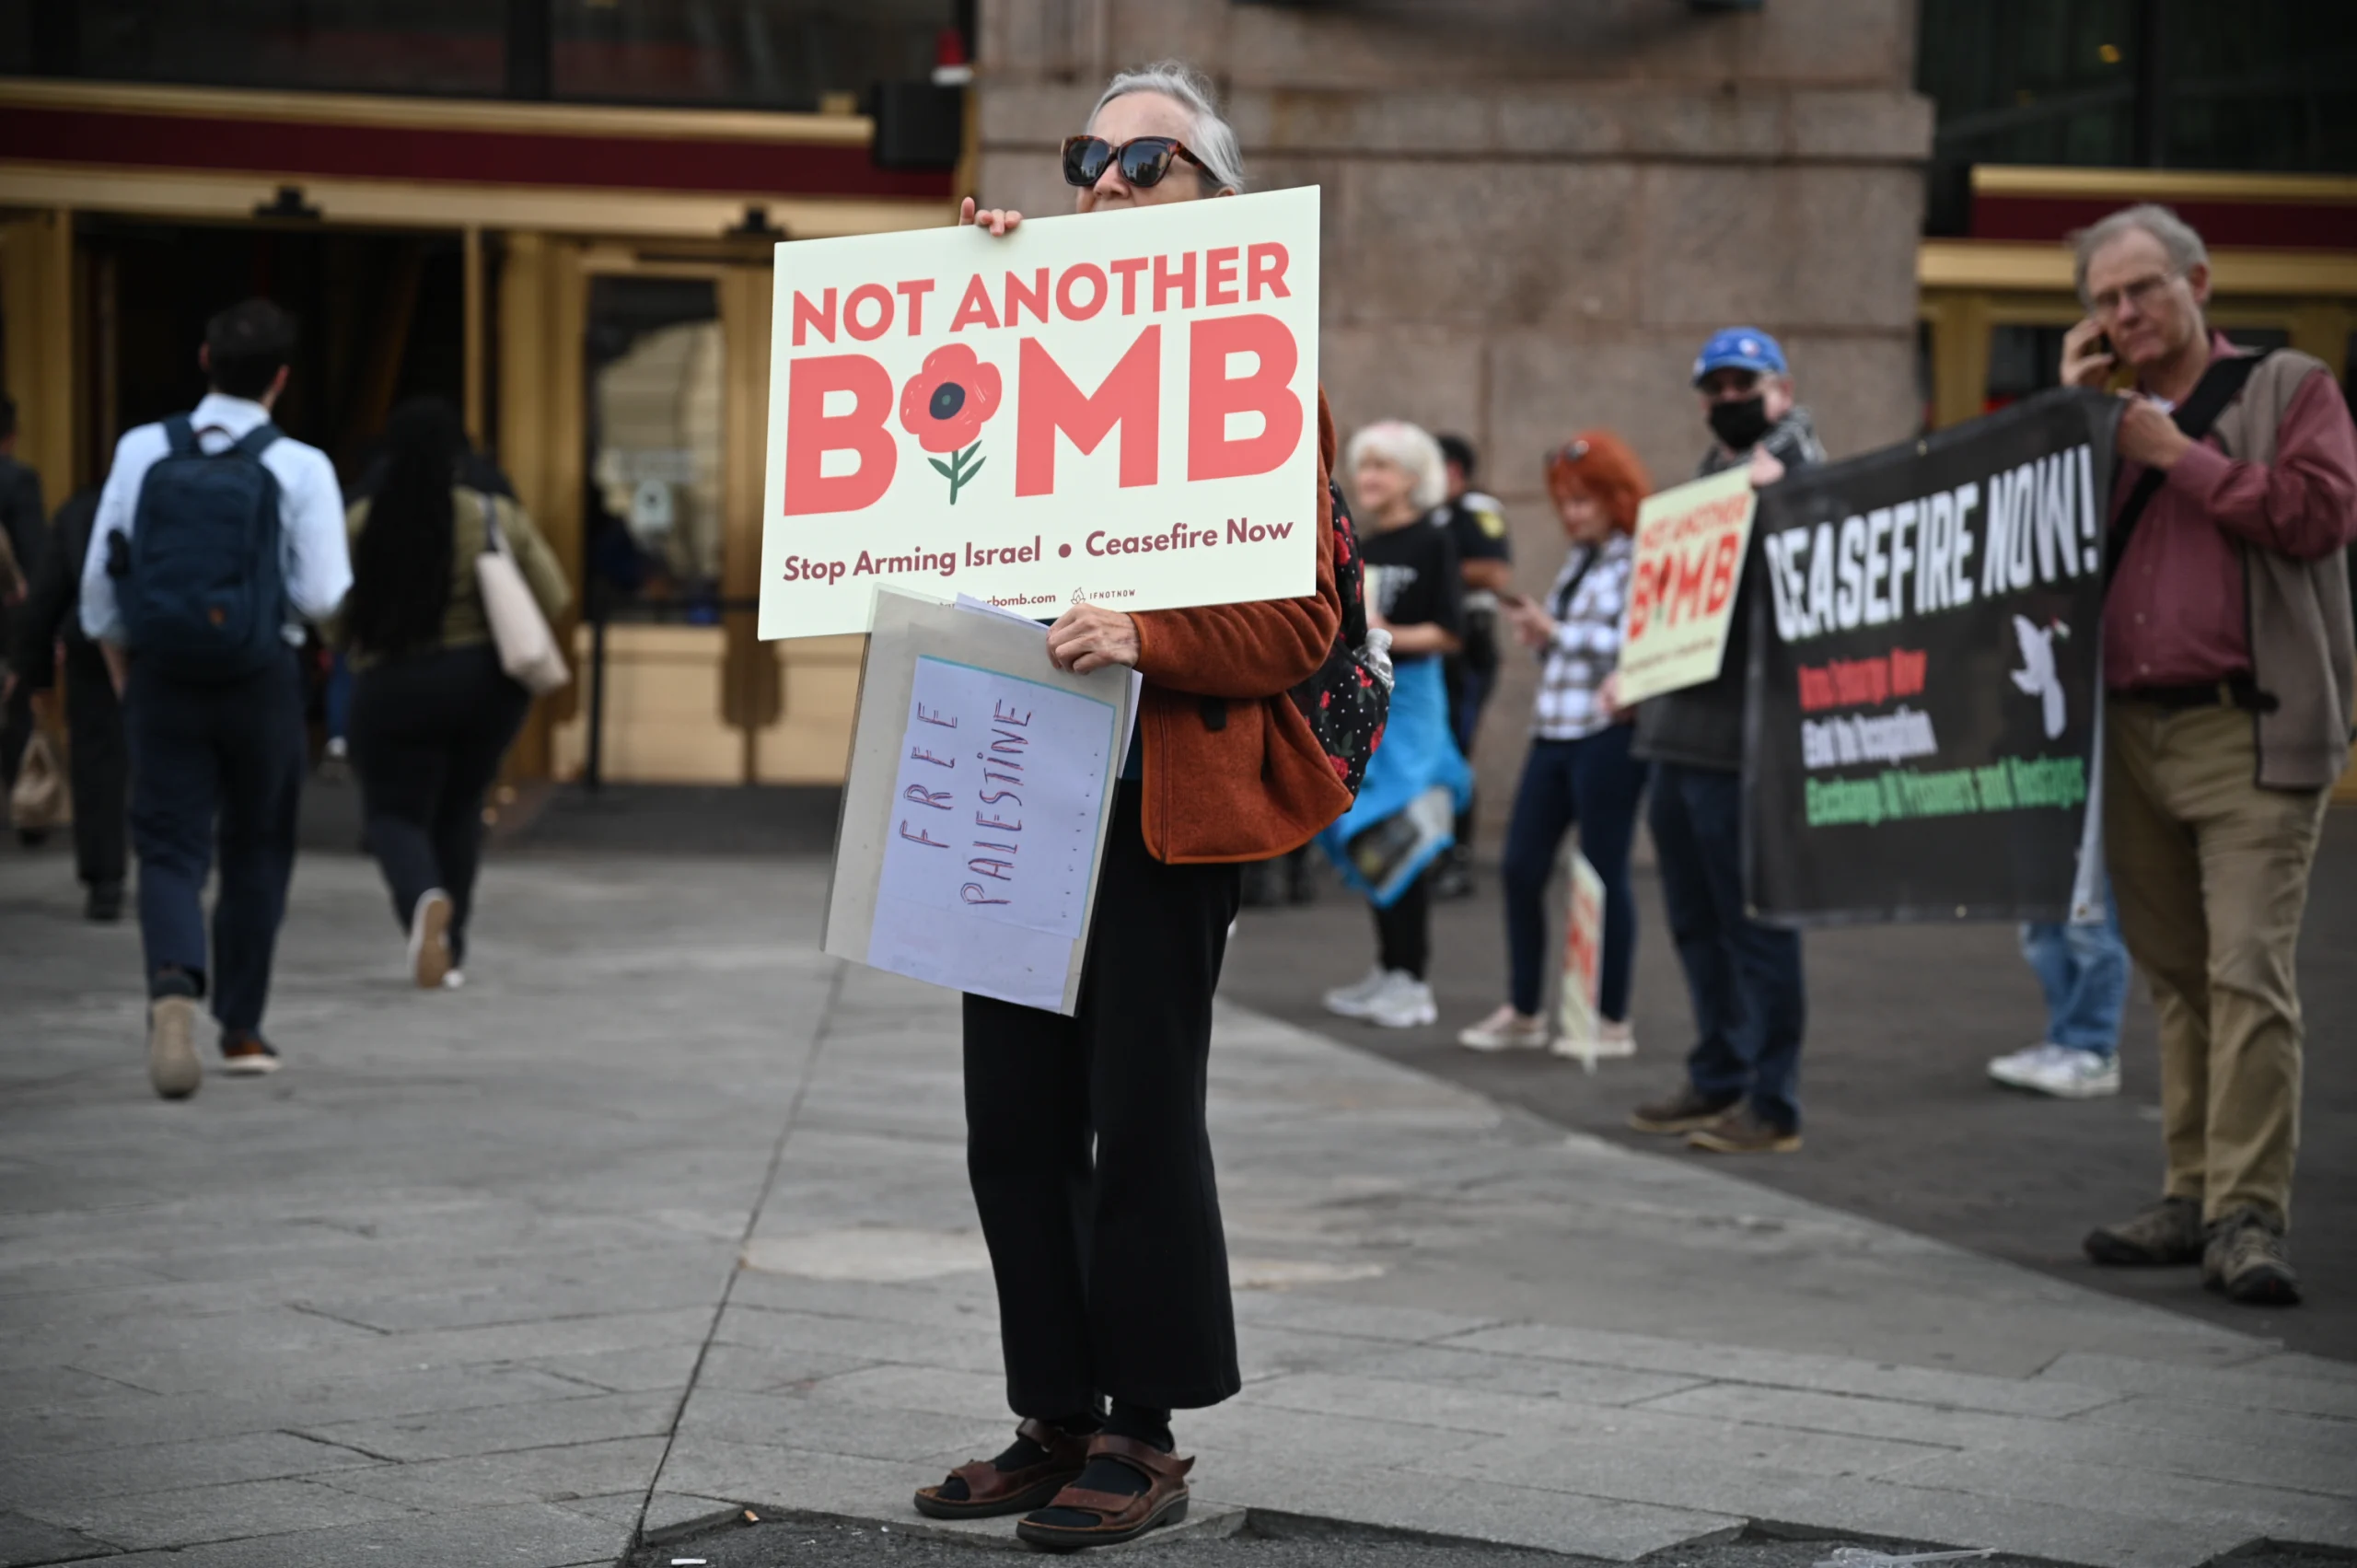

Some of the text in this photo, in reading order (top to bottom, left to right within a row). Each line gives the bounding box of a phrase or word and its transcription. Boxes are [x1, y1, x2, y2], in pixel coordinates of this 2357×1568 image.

[792, 241, 1291, 346] NOT ANOTHER
[783, 517, 1294, 585] Stop Arming Israel Ceasefire Now
[1981, 444, 2098, 598] NOW!
[1088, 589, 1136, 600] IFNOTNOW
[900, 702, 958, 849] FREE
